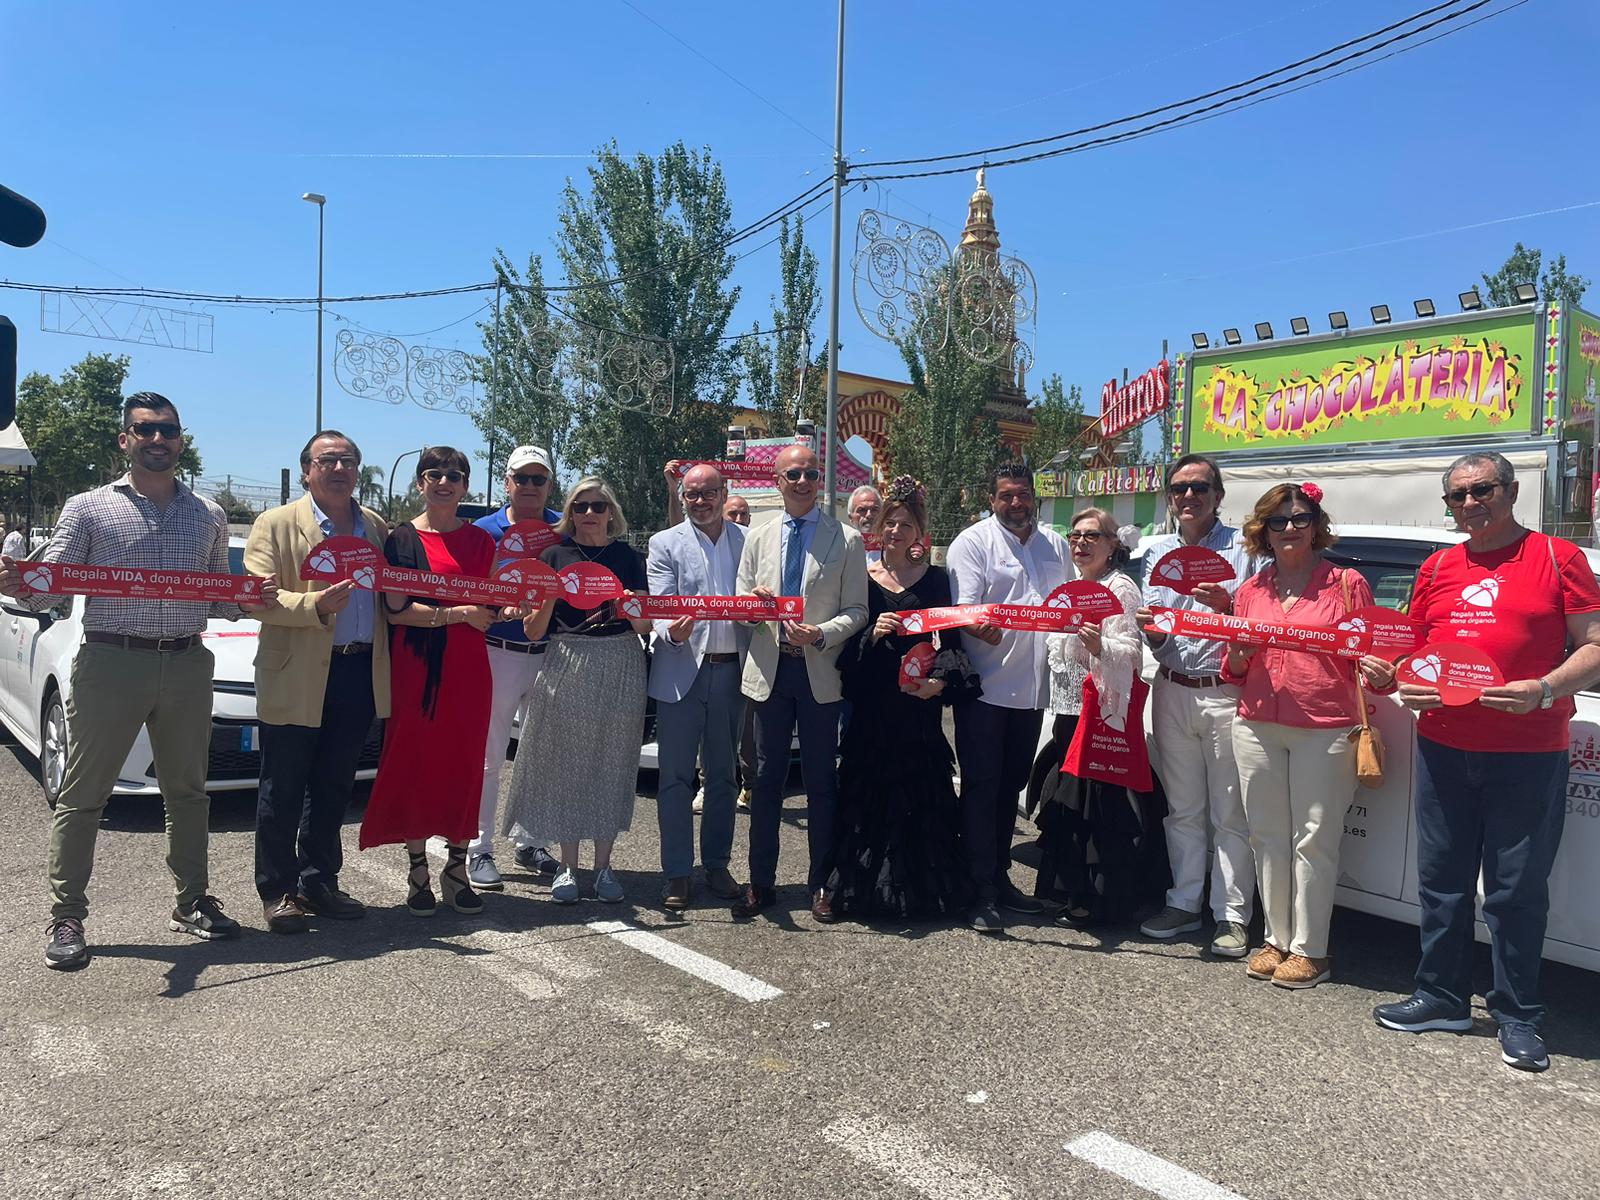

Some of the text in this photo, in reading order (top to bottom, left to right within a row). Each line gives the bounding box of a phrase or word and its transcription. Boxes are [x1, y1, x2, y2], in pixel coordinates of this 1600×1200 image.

[1212, 350, 1507, 431] LA CHOCOLATERIA
[62, 566, 232, 589] Regala VIDA, dona órganos
[382, 567, 418, 582] Regala
[450, 577, 476, 589] dona
[478, 580, 518, 594] órganos
[646, 597, 679, 609] Regala
[709, 598, 734, 608] dona
[736, 597, 776, 610] órganos
[928, 608, 961, 619] Regala
[993, 605, 1018, 617] dona
[1020, 606, 1062, 620] órganos
[1182, 612, 1336, 641] Regala VIDA, dona órganos
[1467, 617, 1497, 625] órganos
[1394, 624, 1412, 632] VIDA
[1389, 631, 1416, 639] órganos
[1449, 662, 1491, 673] regala VIDA
[1448, 668, 1494, 681] dona órganos
[1092, 734, 1112, 743] Regala
